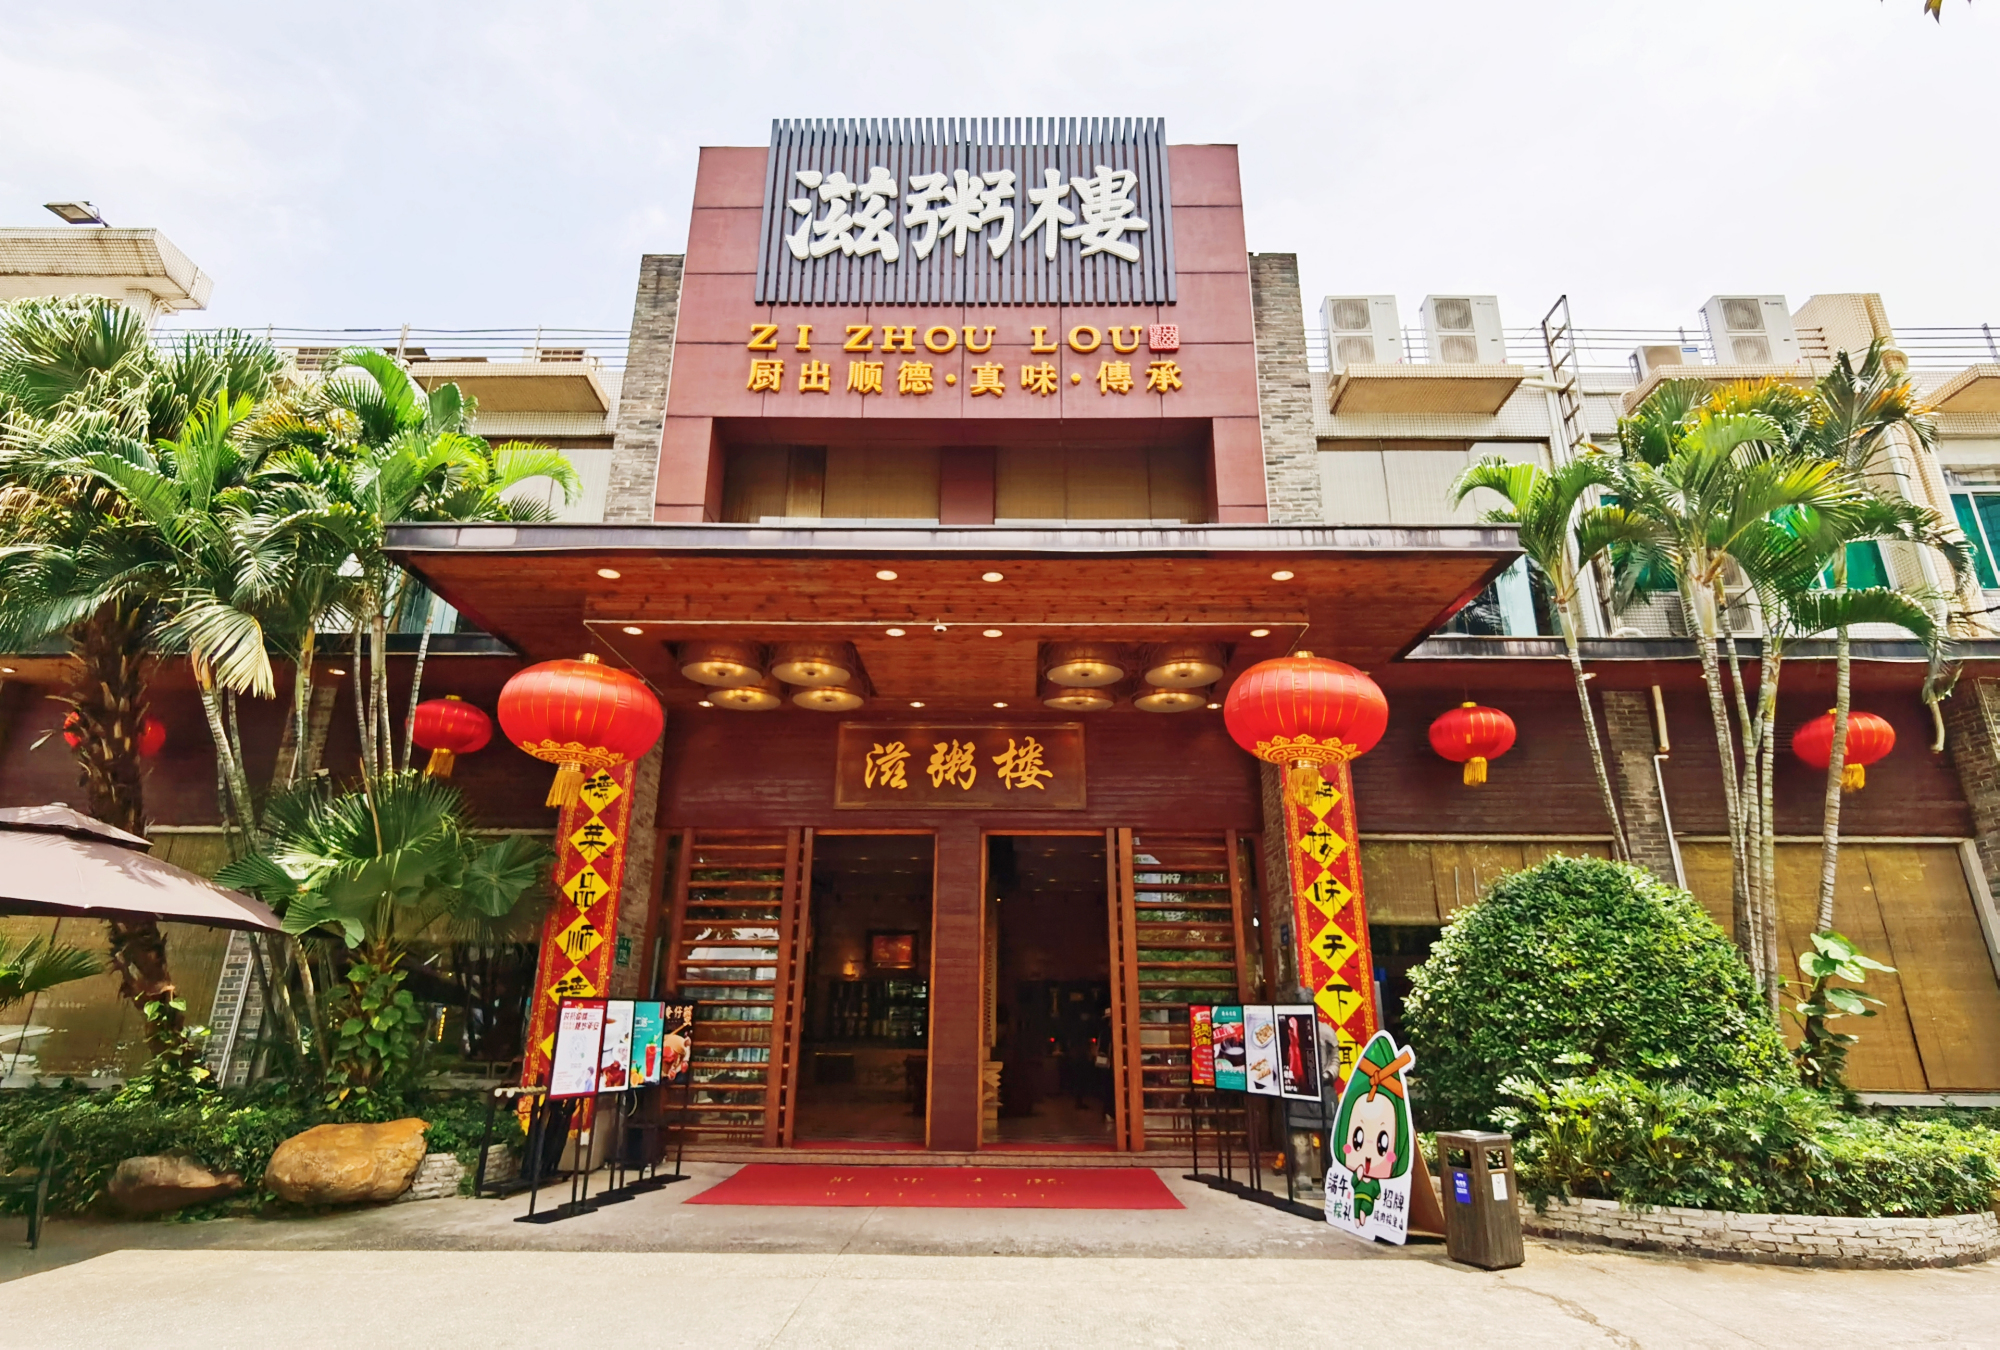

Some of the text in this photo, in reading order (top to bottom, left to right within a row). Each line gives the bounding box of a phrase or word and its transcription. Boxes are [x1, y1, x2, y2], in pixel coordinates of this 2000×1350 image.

[785, 165, 1149, 263] 滋粥樓
[843, 324, 997, 353] ZHOU
[1030, 325, 1144, 353] LOU
[864, 736, 1054, 791] 滋粥楼
[1327, 1172, 1349, 1198] 端午
[1383, 1188, 1405, 1213] 招牌
